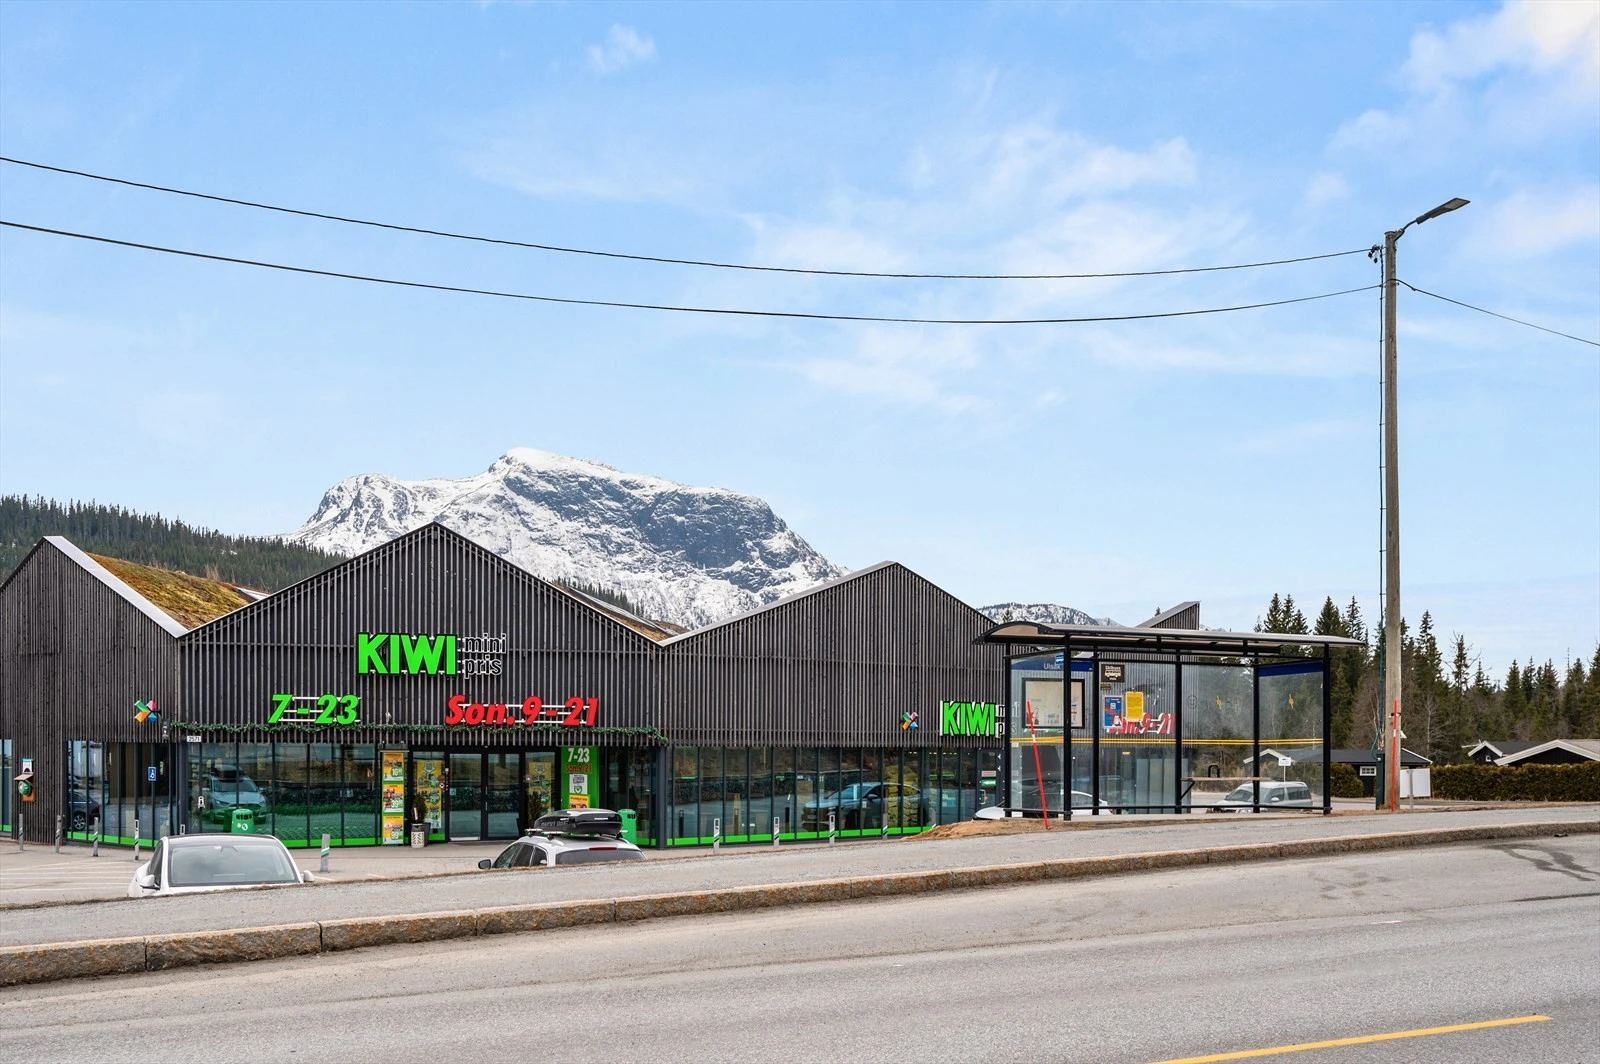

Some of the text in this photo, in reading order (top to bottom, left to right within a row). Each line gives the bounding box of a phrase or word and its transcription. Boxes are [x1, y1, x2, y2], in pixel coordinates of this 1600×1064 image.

[358, 633, 507, 675] KIWI mini
[464, 655, 502, 679] pris
[445, 694, 515, 726] Son.
[940, 700, 996, 736] KIWI
